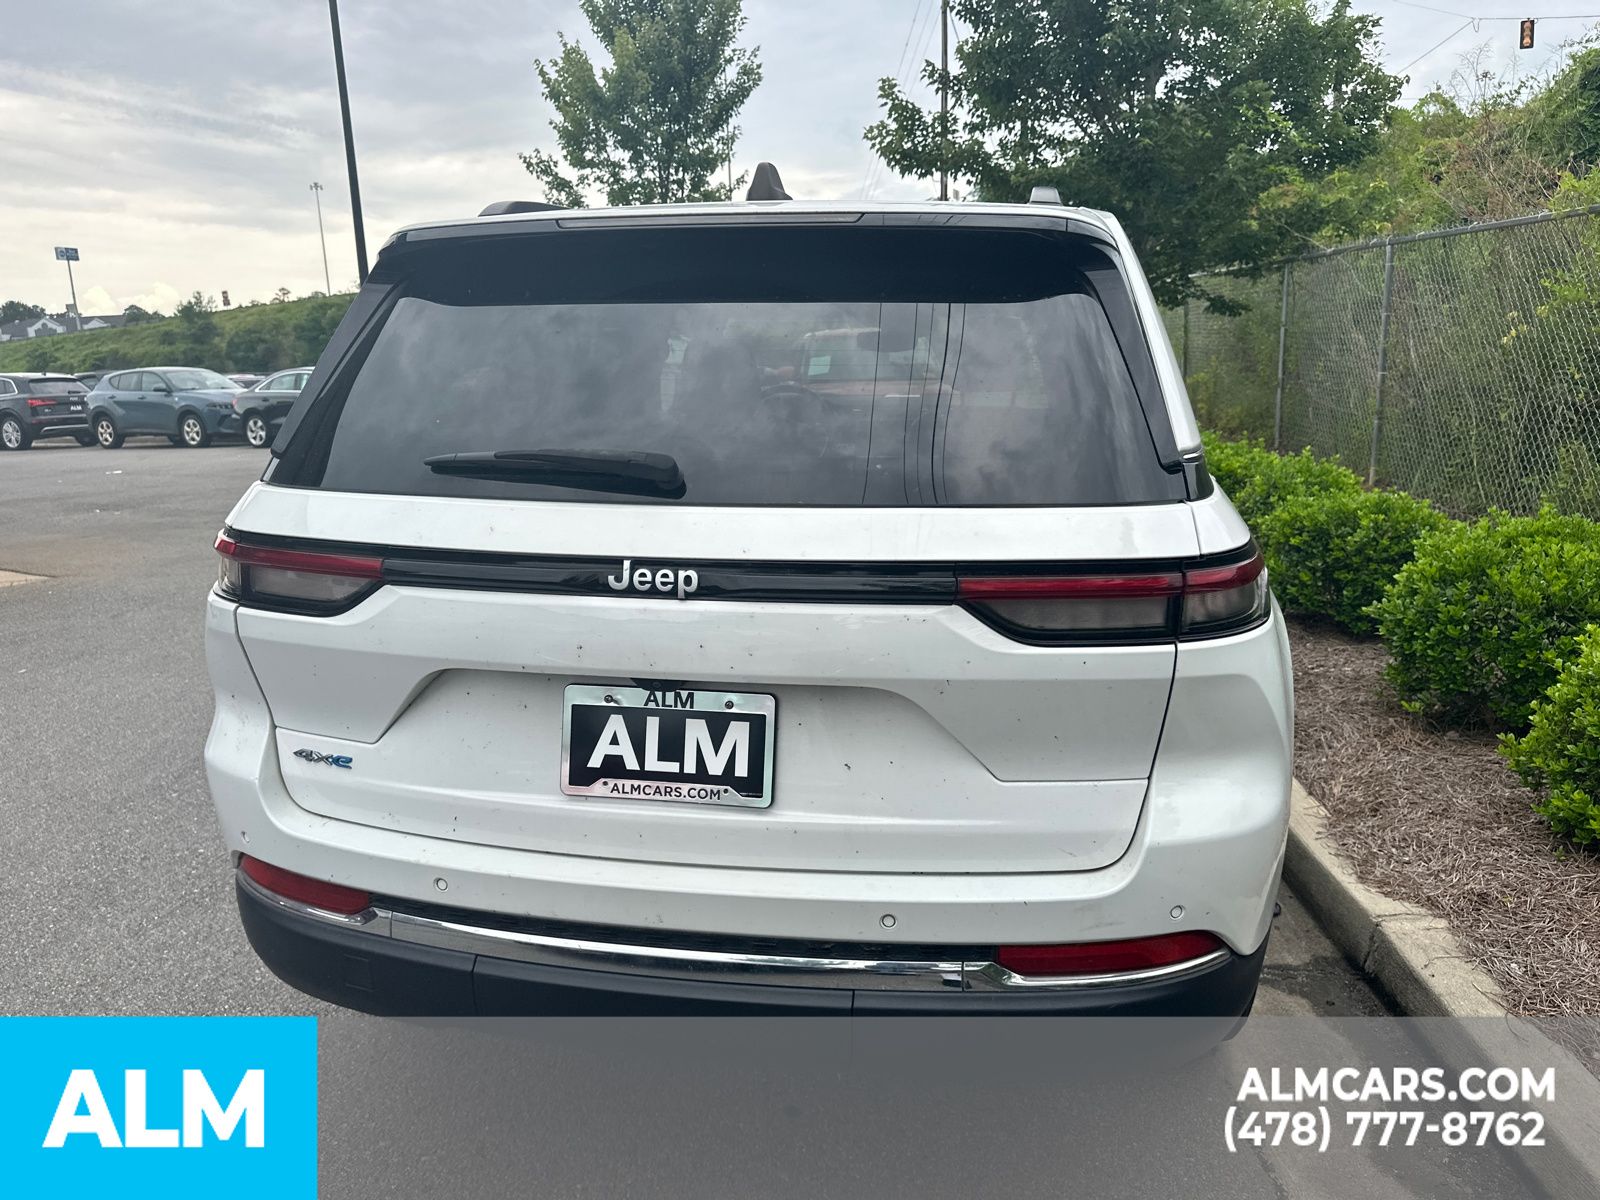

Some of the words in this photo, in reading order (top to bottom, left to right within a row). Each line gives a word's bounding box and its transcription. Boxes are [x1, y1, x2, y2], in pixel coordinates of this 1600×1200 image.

[607, 559, 699, 600] Jeep
[643, 690, 695, 709] ALM
[586, 714, 750, 778] ALM
[609, 782, 721, 801] ALMCARS.COM
